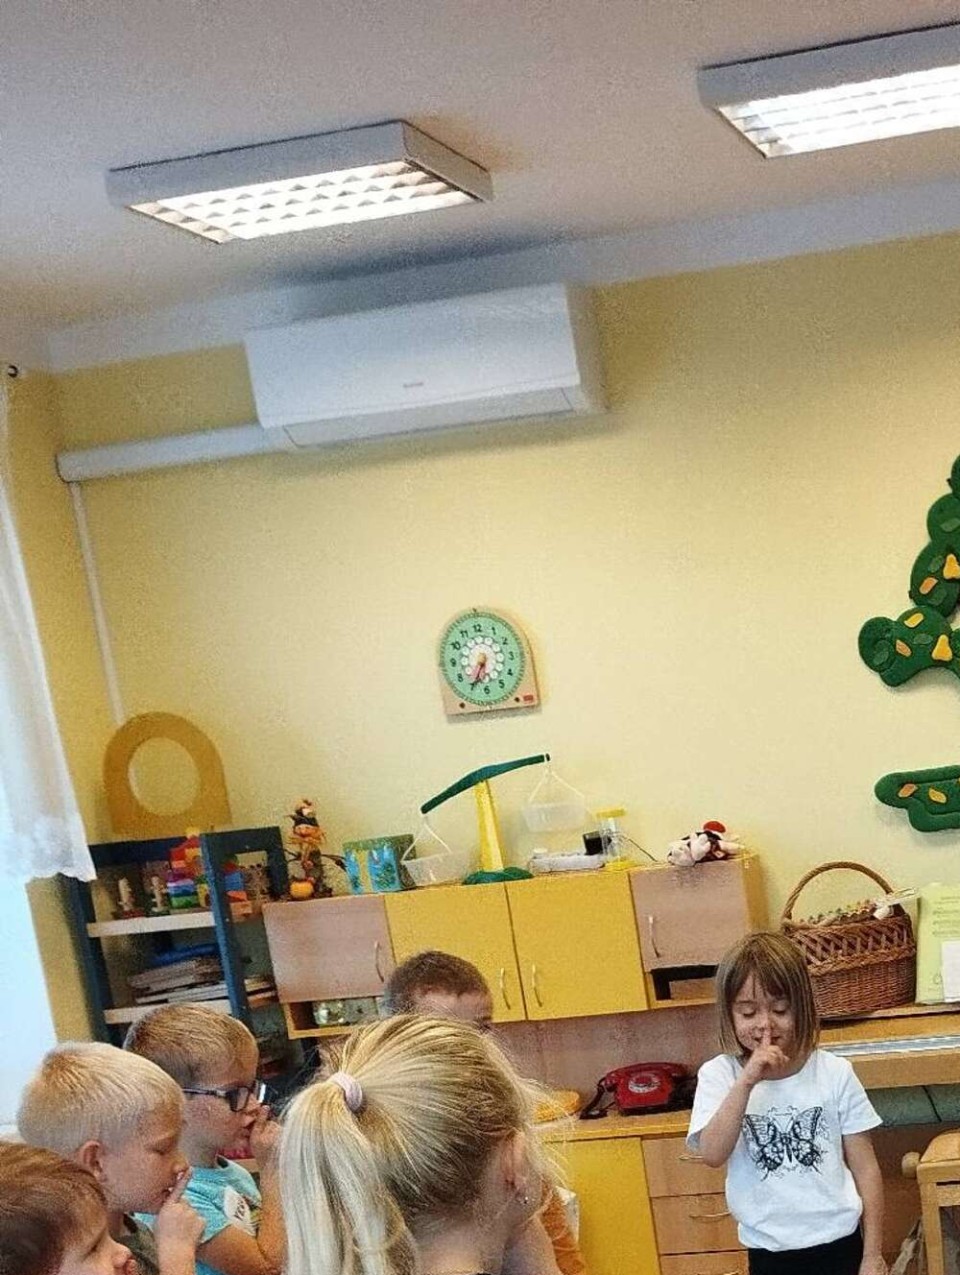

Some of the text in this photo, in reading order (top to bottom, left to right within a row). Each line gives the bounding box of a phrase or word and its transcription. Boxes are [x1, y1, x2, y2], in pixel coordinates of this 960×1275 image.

[473, 624, 482, 633] 12
[491, 627, 497, 635] 1
[461, 630, 469, 638] 11
[450, 642, 461, 651] 10
[509, 651, 515, 661] 3
[450, 658, 457, 667] 9
[457, 673, 464, 683] 8
[498, 679, 505, 689] 5
[484, 686, 490, 695] 6
